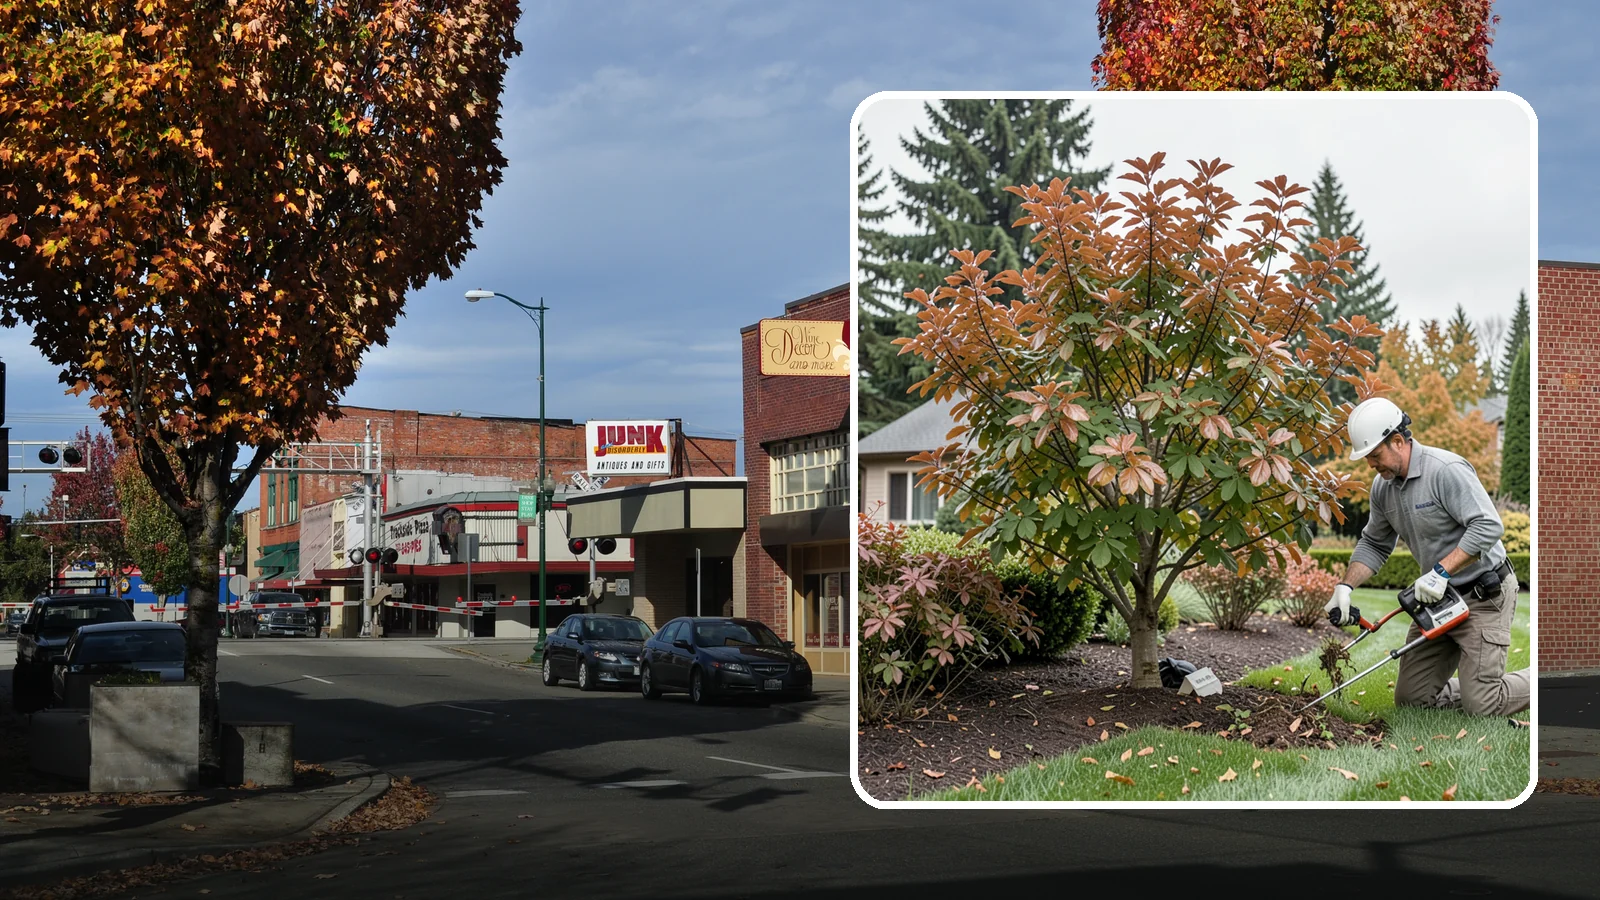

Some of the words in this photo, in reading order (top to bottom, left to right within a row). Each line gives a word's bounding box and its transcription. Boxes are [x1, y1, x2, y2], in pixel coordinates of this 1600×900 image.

[596, 425, 665, 457] JUNK
[607, 446, 646, 454] DISORDERLY
[596, 461, 628, 470] ANTIQUES
[631, 461, 644, 470] AND
[646, 460, 665, 470] GIFTS
